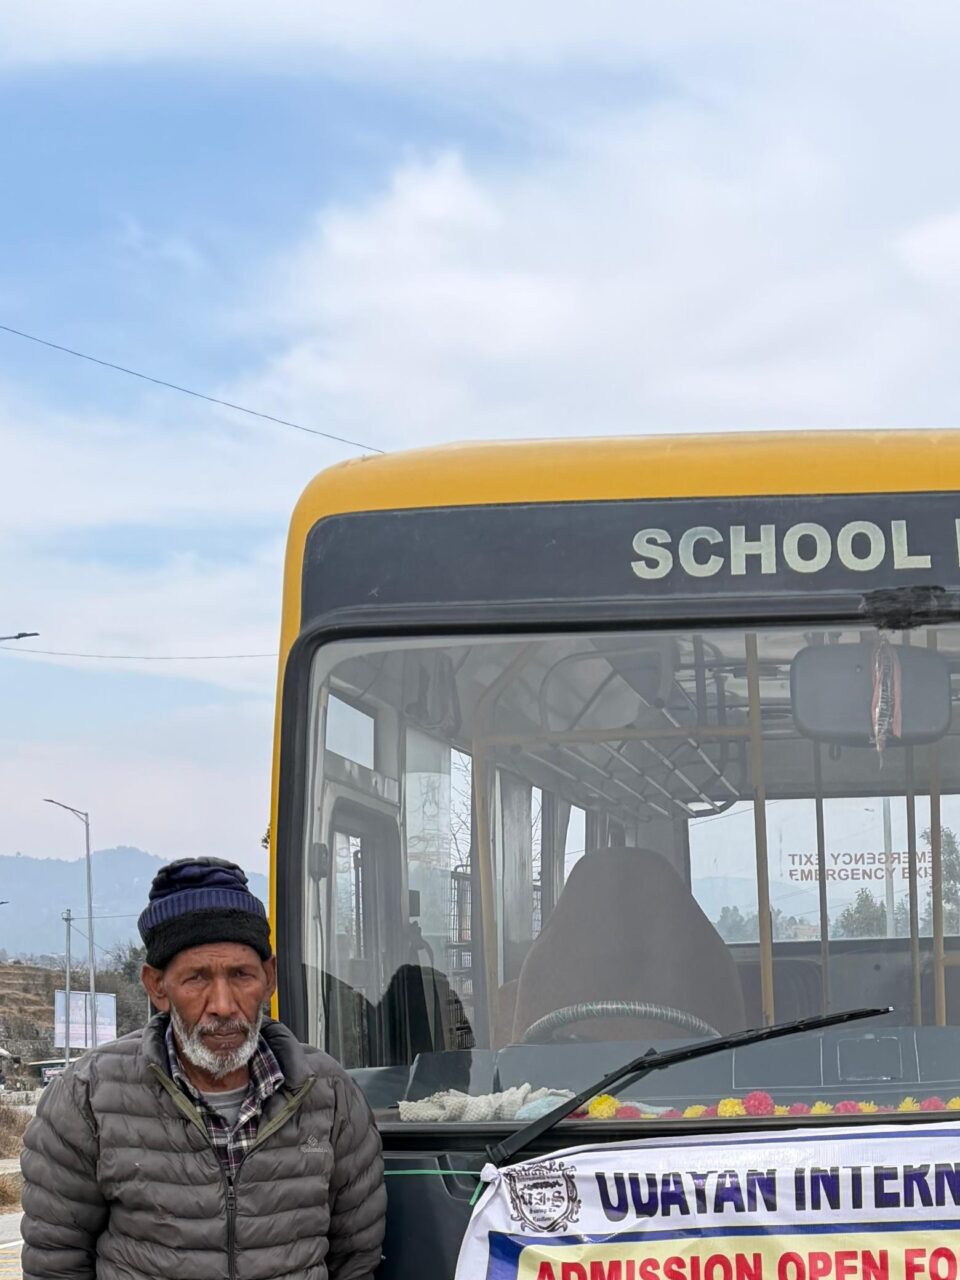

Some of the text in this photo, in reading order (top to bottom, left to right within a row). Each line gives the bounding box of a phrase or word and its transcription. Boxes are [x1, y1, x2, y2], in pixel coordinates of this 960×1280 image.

[631, 520, 932, 579] SCHOOL
[902, 866, 932, 879] EXI
[595, 1169, 777, 1222] UDAYAN
